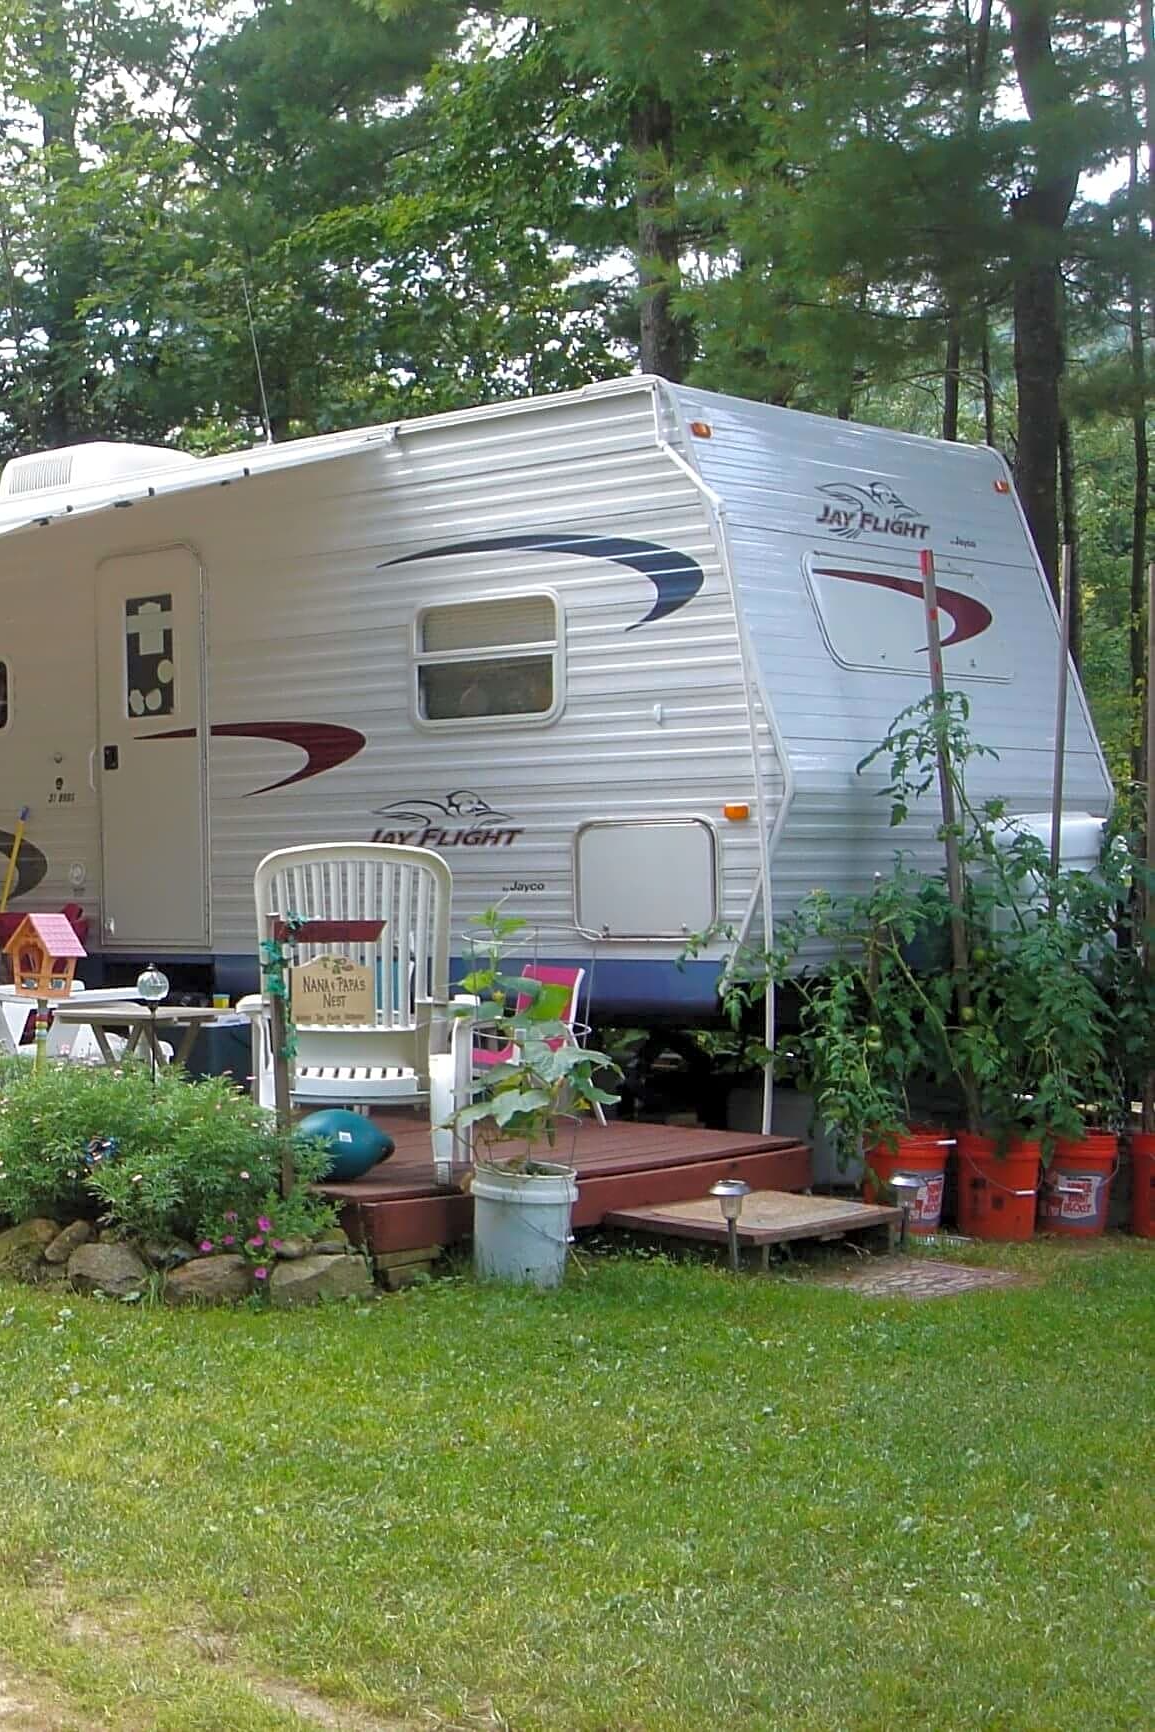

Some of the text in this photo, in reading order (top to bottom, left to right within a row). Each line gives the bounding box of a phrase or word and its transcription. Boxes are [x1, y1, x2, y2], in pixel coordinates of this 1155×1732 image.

[816, 504, 930, 540] JAY FLIGHT
[369, 828, 526, 847] JAY FLIGHT
[510, 879, 545, 892] Jayco
[303, 976, 332, 993] NANA
[336, 976, 367, 992] PAPA'S
[323, 993, 348, 1009] NEST
